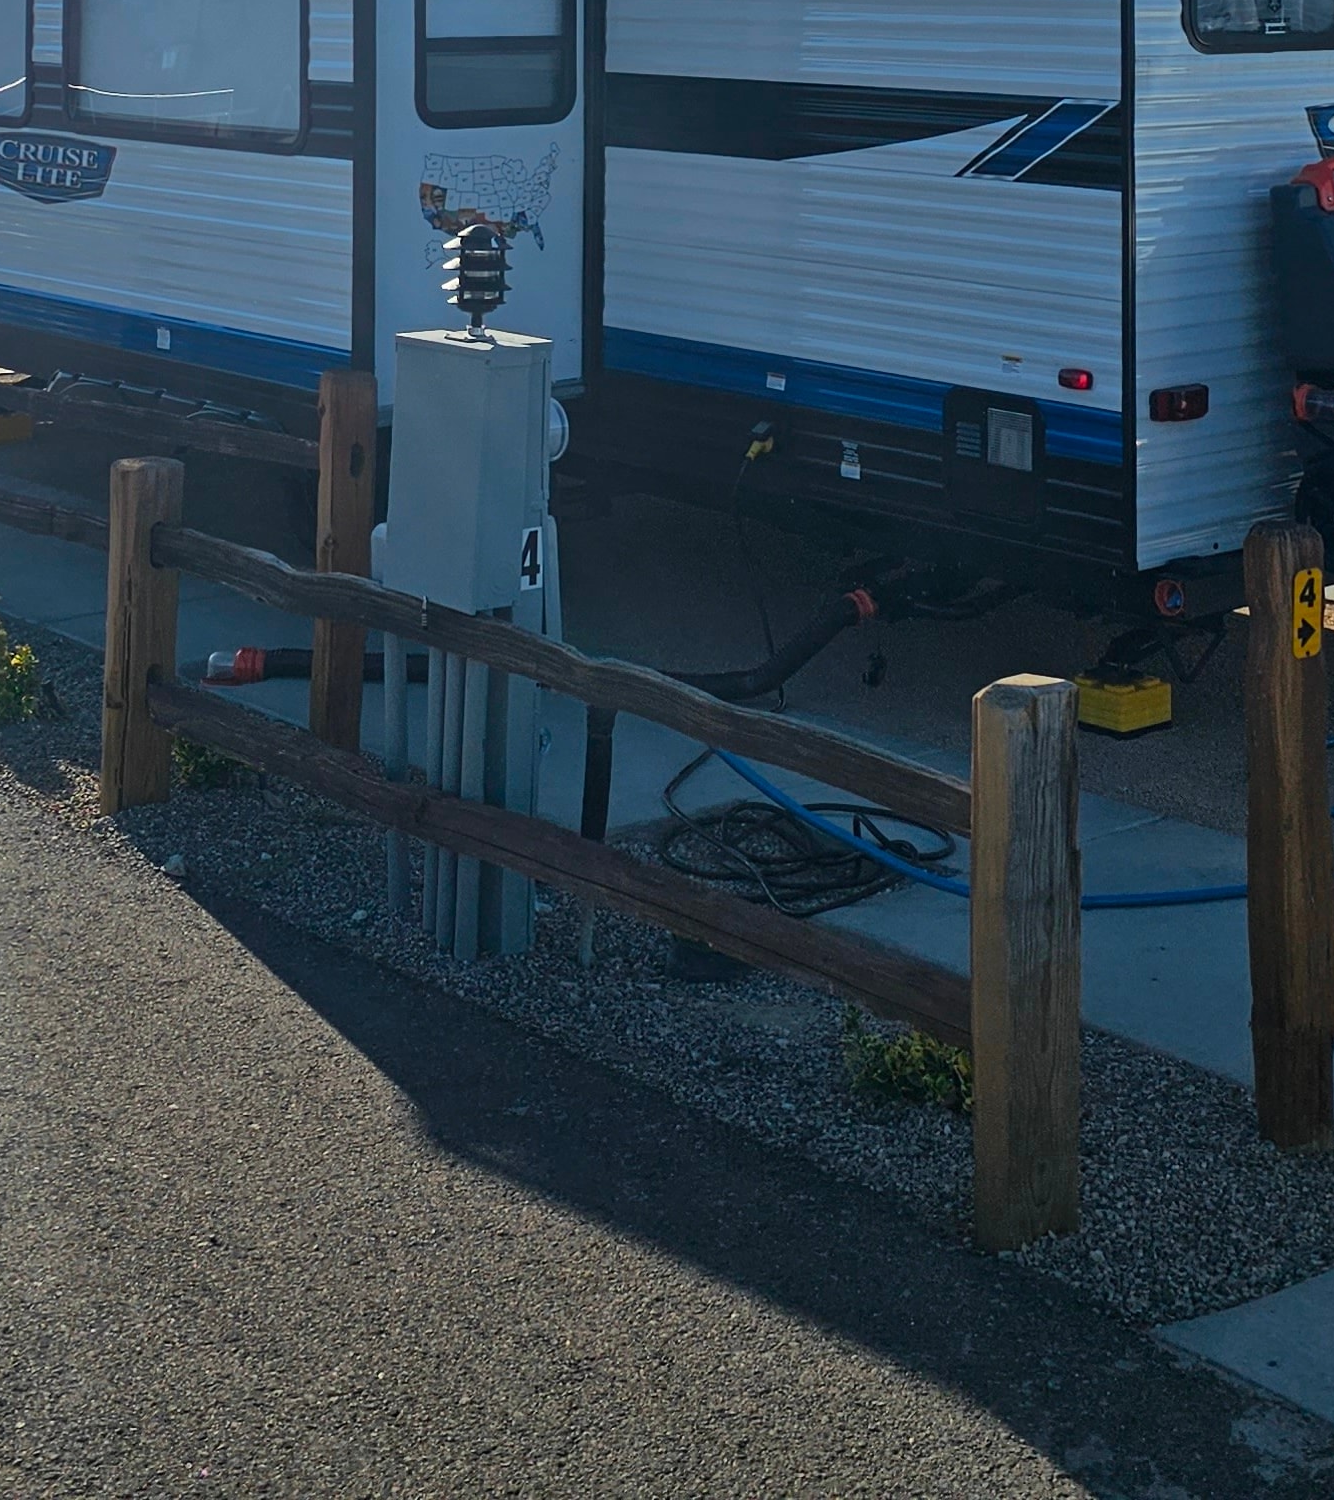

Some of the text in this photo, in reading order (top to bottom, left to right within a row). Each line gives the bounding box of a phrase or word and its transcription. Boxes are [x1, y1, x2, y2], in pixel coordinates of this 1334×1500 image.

[16, 161, 82, 188] LITE
[521, 530, 540, 586] 4
[1299, 577, 1316, 607] 4
